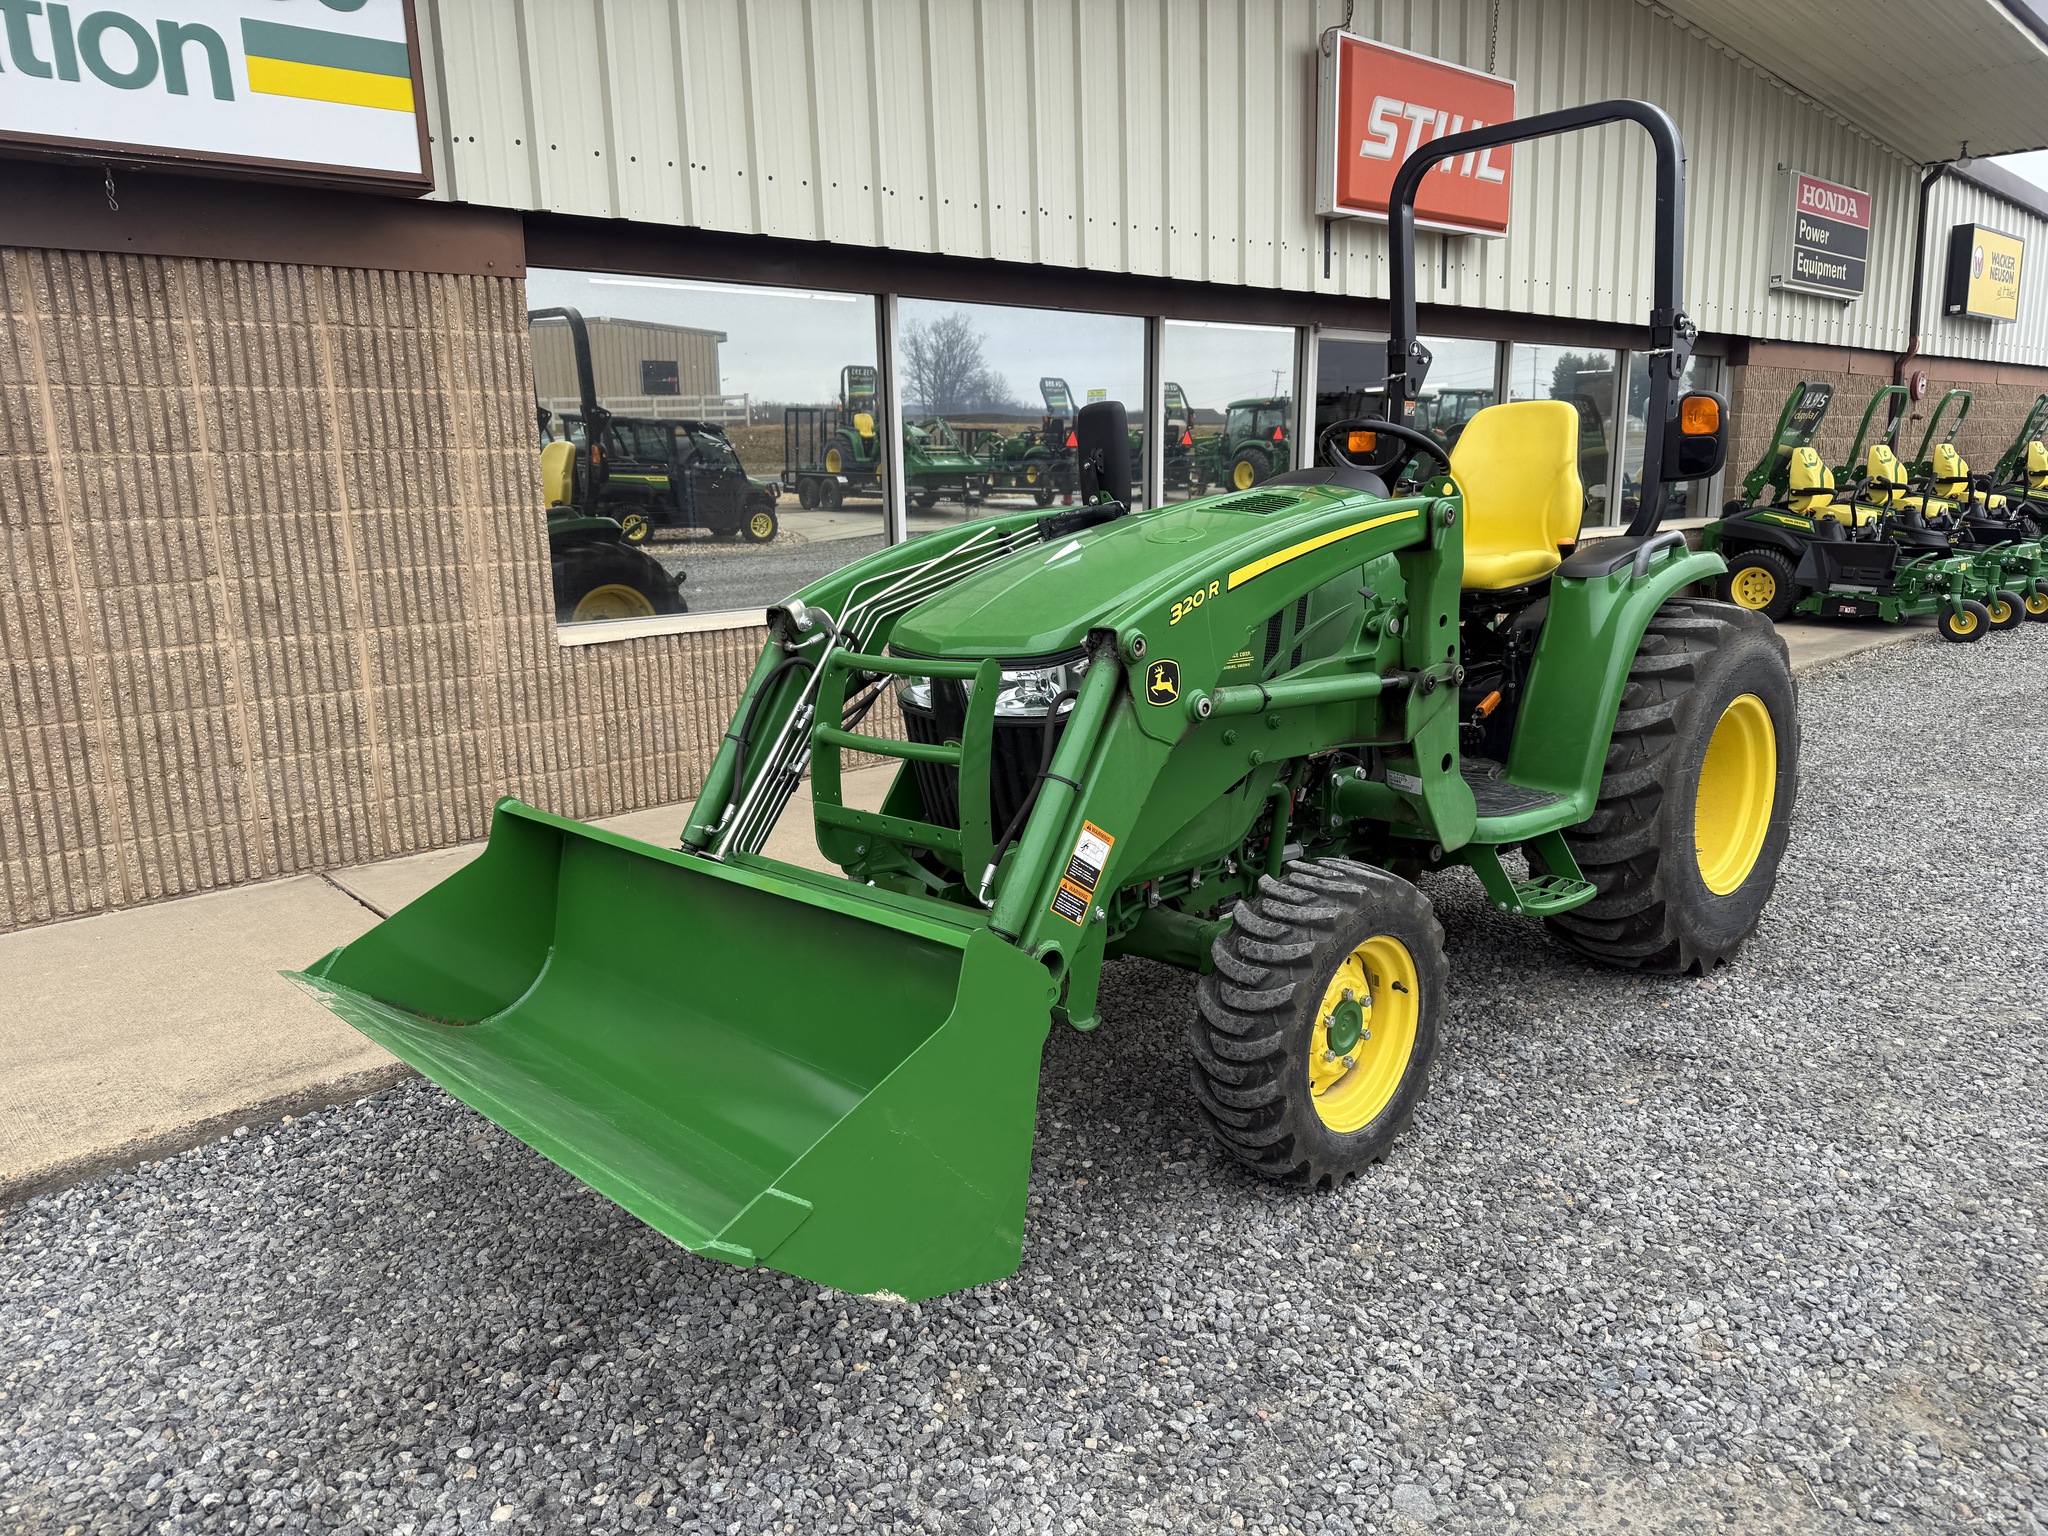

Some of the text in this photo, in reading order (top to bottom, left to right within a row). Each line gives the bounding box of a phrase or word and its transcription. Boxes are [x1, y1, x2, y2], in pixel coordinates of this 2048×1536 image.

[0, 0, 235, 101] tion
[1359, 95, 1506, 184] STIHL
[1801, 183, 1859, 219] HONDA
[1799, 218, 1830, 245] Power
[1796, 252, 1847, 281] Equipment
[1991, 251, 2015, 270] WACKER
[1989, 266, 2015, 284] NEUSON
[1169, 579, 1220, 626] 320 R
[1091, 828, 1111, 843] WARNING
[1068, 886, 1089, 900] WARNING
